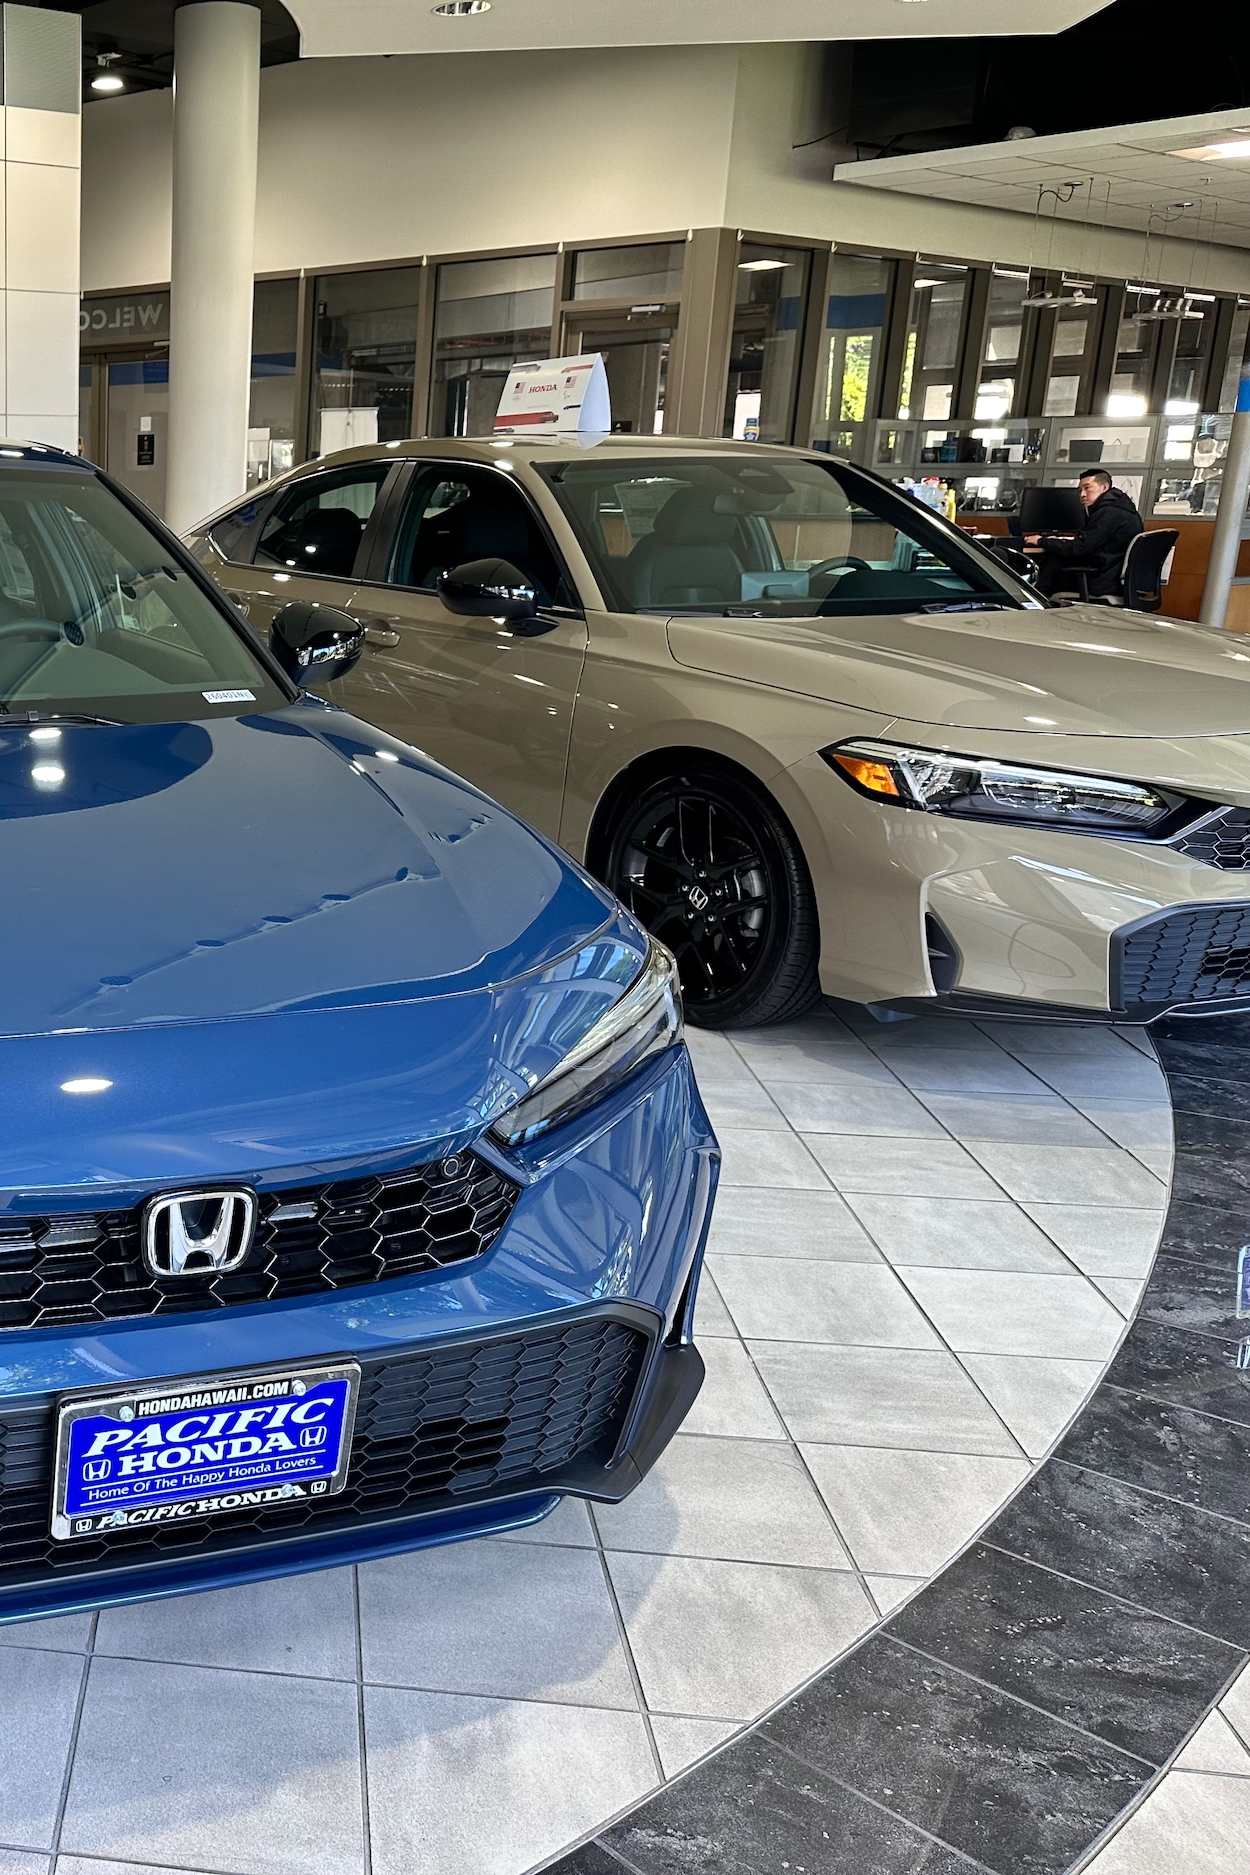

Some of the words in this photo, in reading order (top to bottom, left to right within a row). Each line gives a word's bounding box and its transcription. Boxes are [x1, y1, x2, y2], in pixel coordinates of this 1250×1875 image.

[529, 384, 558, 394] HONDA
[139, 1381, 289, 1416] HONDAHAWAII.COM
[82, 1398, 334, 1458] PACIFIC
[117, 1432, 297, 1477] HONDA
[89, 1486, 129, 1501] Home
[133, 1481, 151, 1493] Of
[154, 1477, 178, 1490] The
[182, 1471, 225, 1487] Happy
[228, 1464, 271, 1479] Honda
[275, 1457, 317, 1471] Lovers
